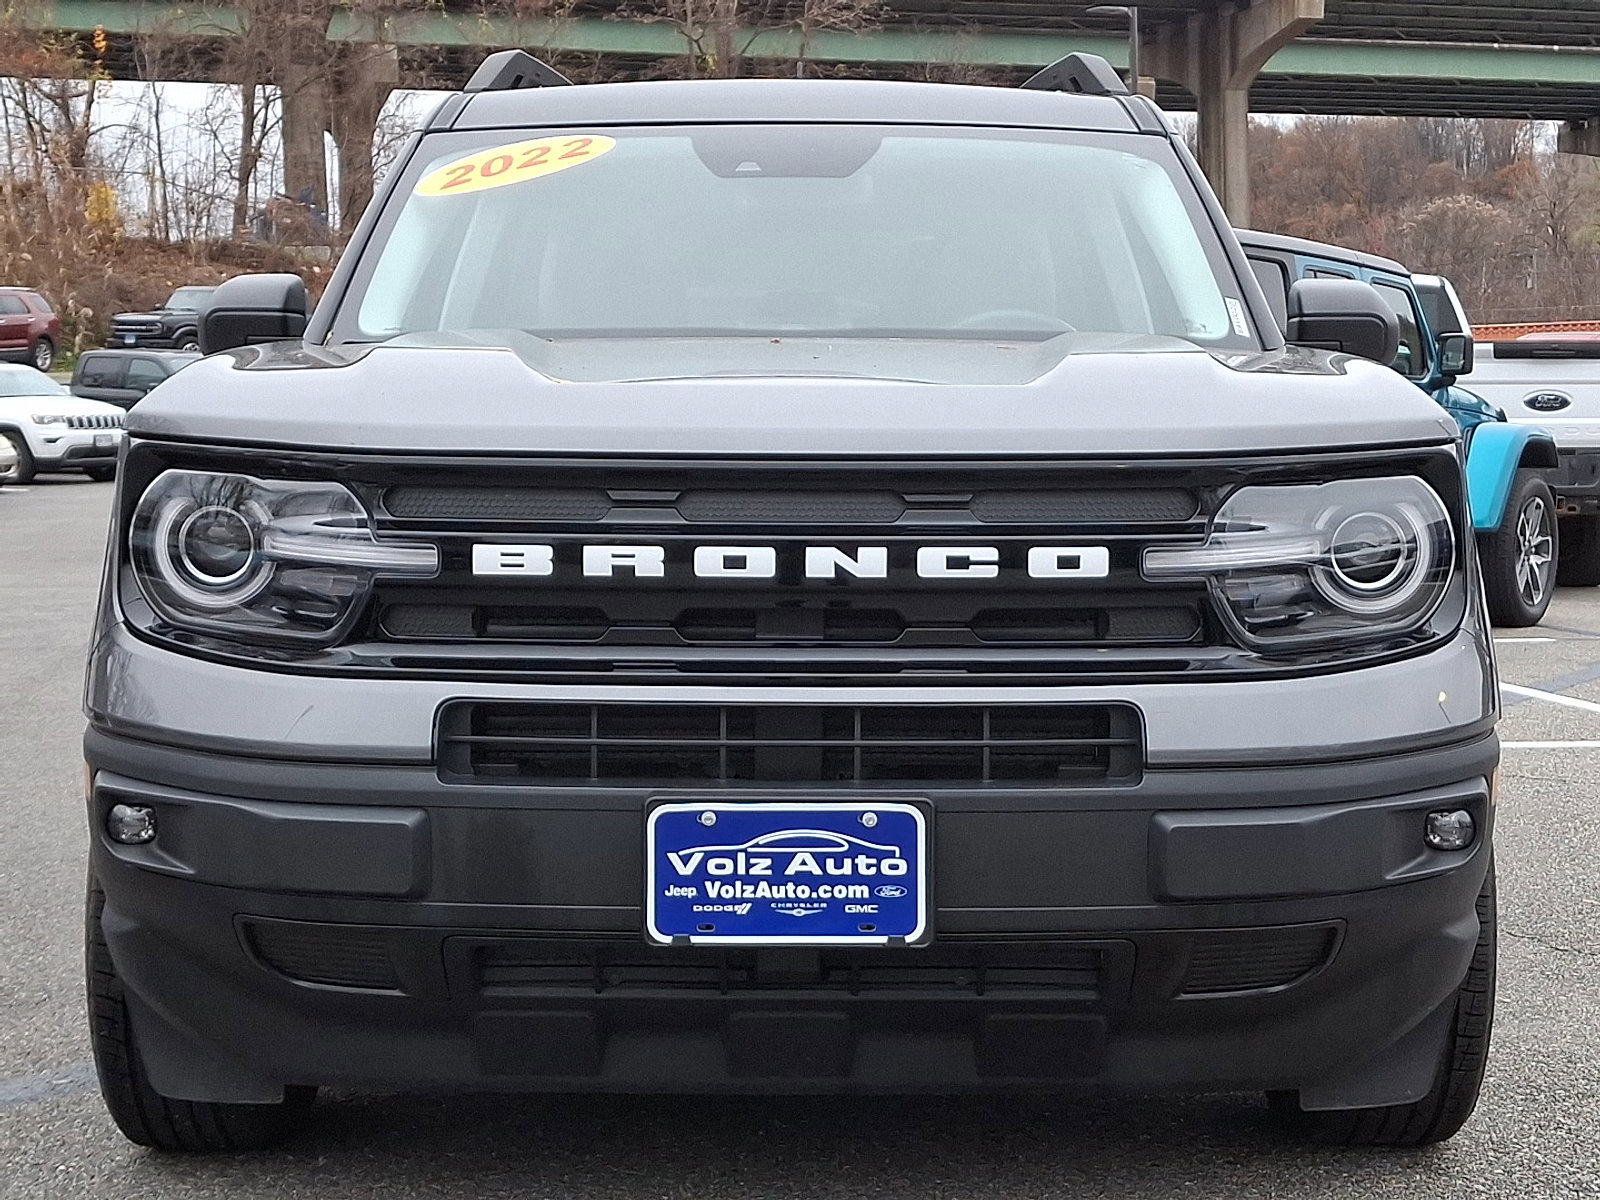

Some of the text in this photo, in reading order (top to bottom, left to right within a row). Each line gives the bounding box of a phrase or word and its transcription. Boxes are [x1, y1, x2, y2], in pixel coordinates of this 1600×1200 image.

[440, 138, 593, 190] 2022
[472, 543, 1110, 578] BRONCO
[667, 852, 908, 876] Volz Auto
[664, 885, 697, 898] Jeep
[704, 880, 869, 899] VolzAuto.com
[845, 905, 879, 914] GMC
